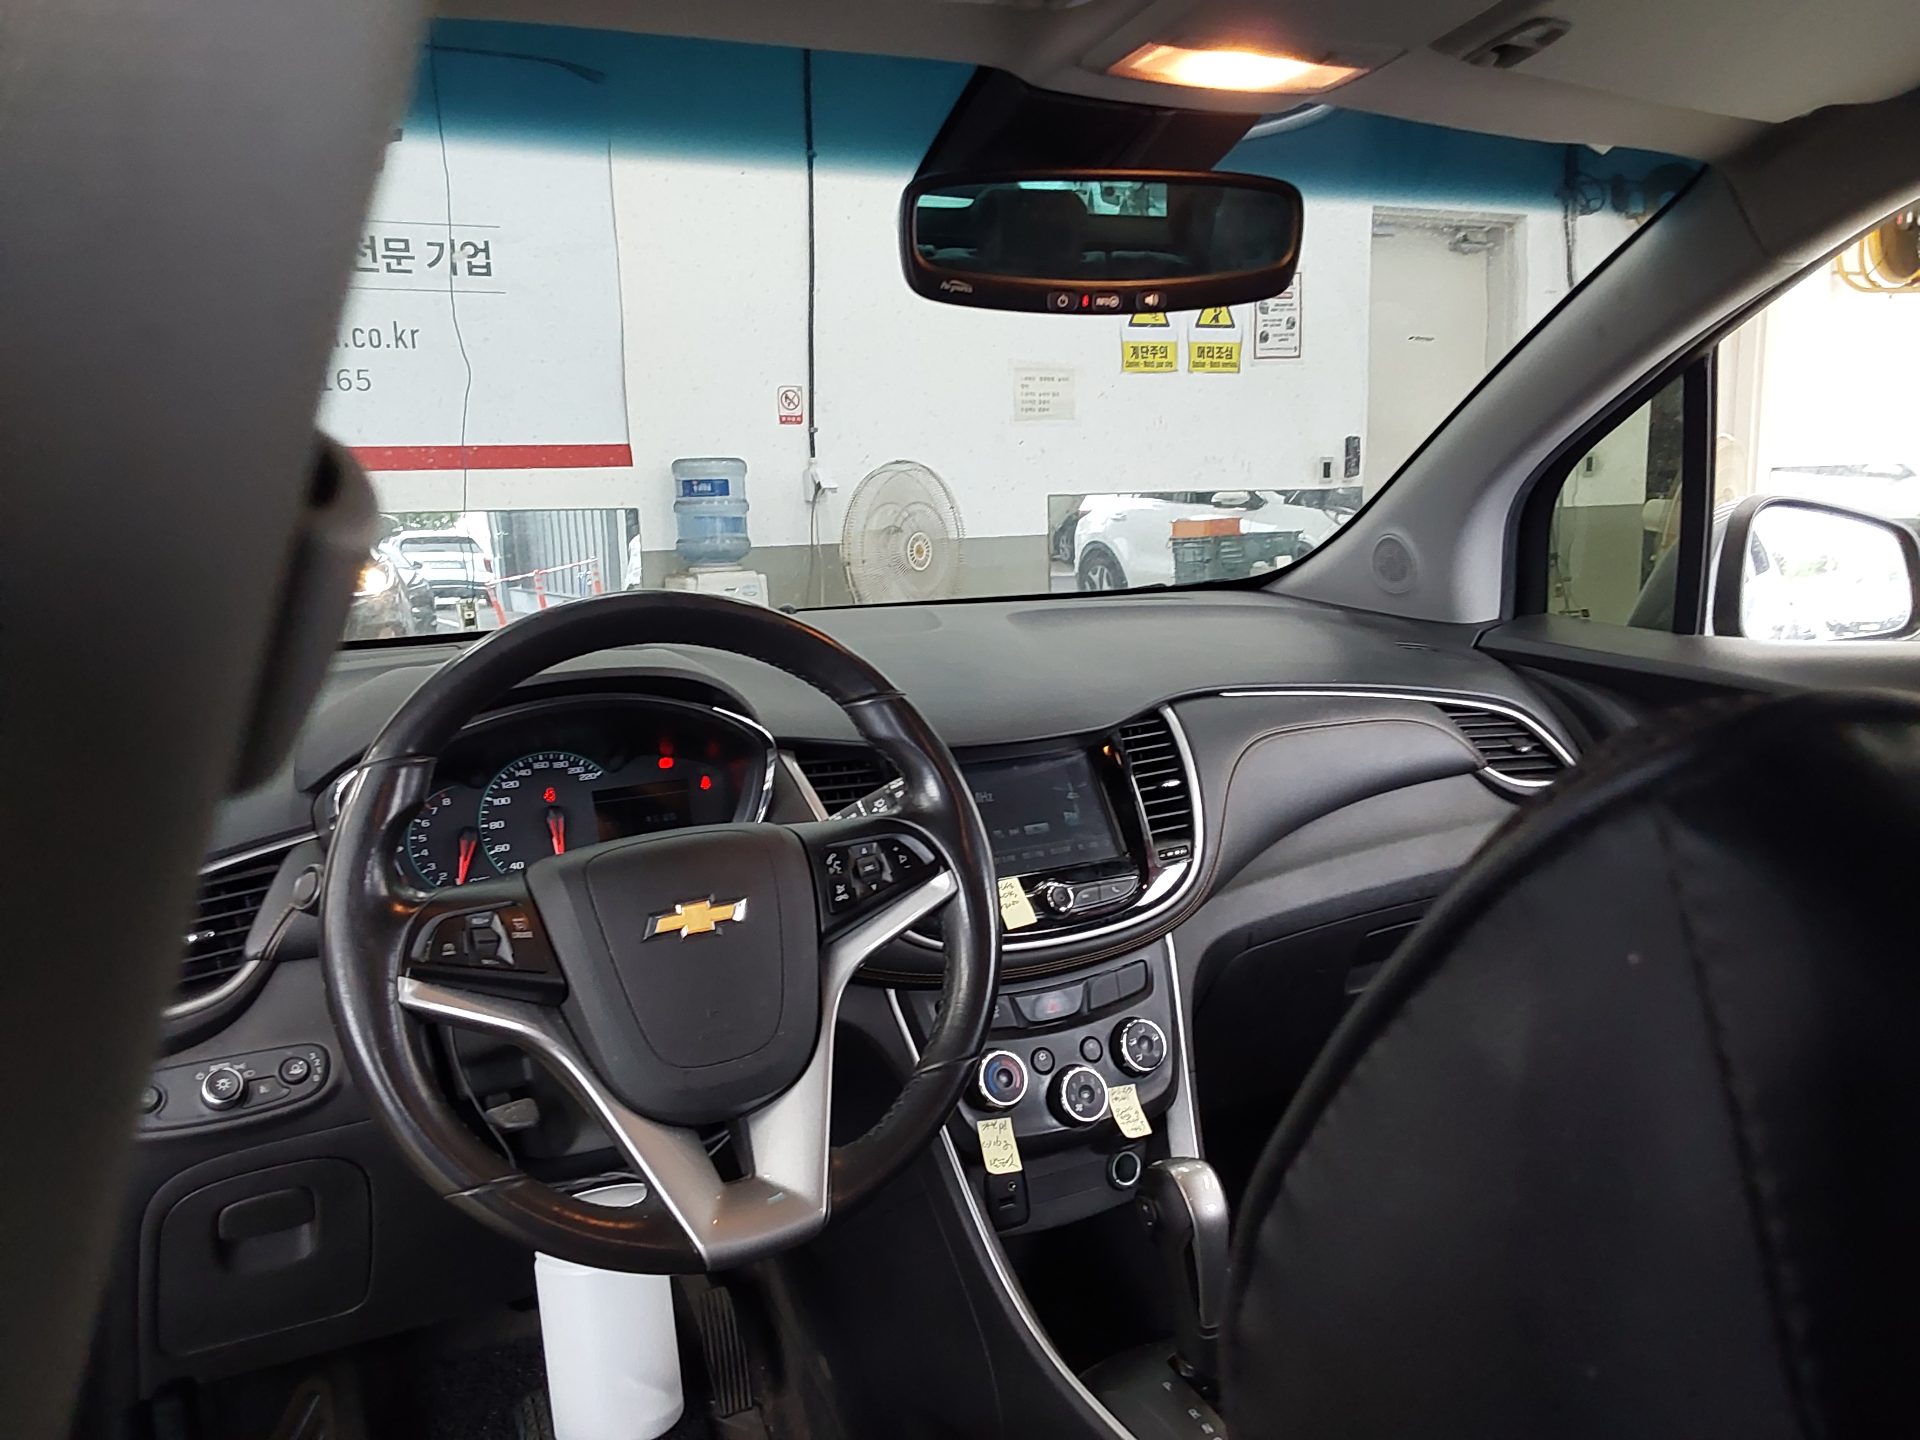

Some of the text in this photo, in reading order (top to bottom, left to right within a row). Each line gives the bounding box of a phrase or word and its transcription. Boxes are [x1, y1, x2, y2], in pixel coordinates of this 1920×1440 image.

[426, 238, 492, 277] 기업
[335, 320, 419, 349] .co.kr
[1130, 345, 1169, 360] 계단주의
[1197, 345, 1234, 360] 머리조심
[501, 780, 520, 789] 120
[493, 797, 511, 806] 100
[430, 806, 438, 815] 7
[420, 820, 431, 828] 6
[489, 821, 505, 830] 80
[417, 834, 427, 843] 5
[495, 843, 510, 853] 60
[427, 862, 437, 871] 3
[509, 862, 525, 870] 40
[1188, 1408, 1202, 1419] R
